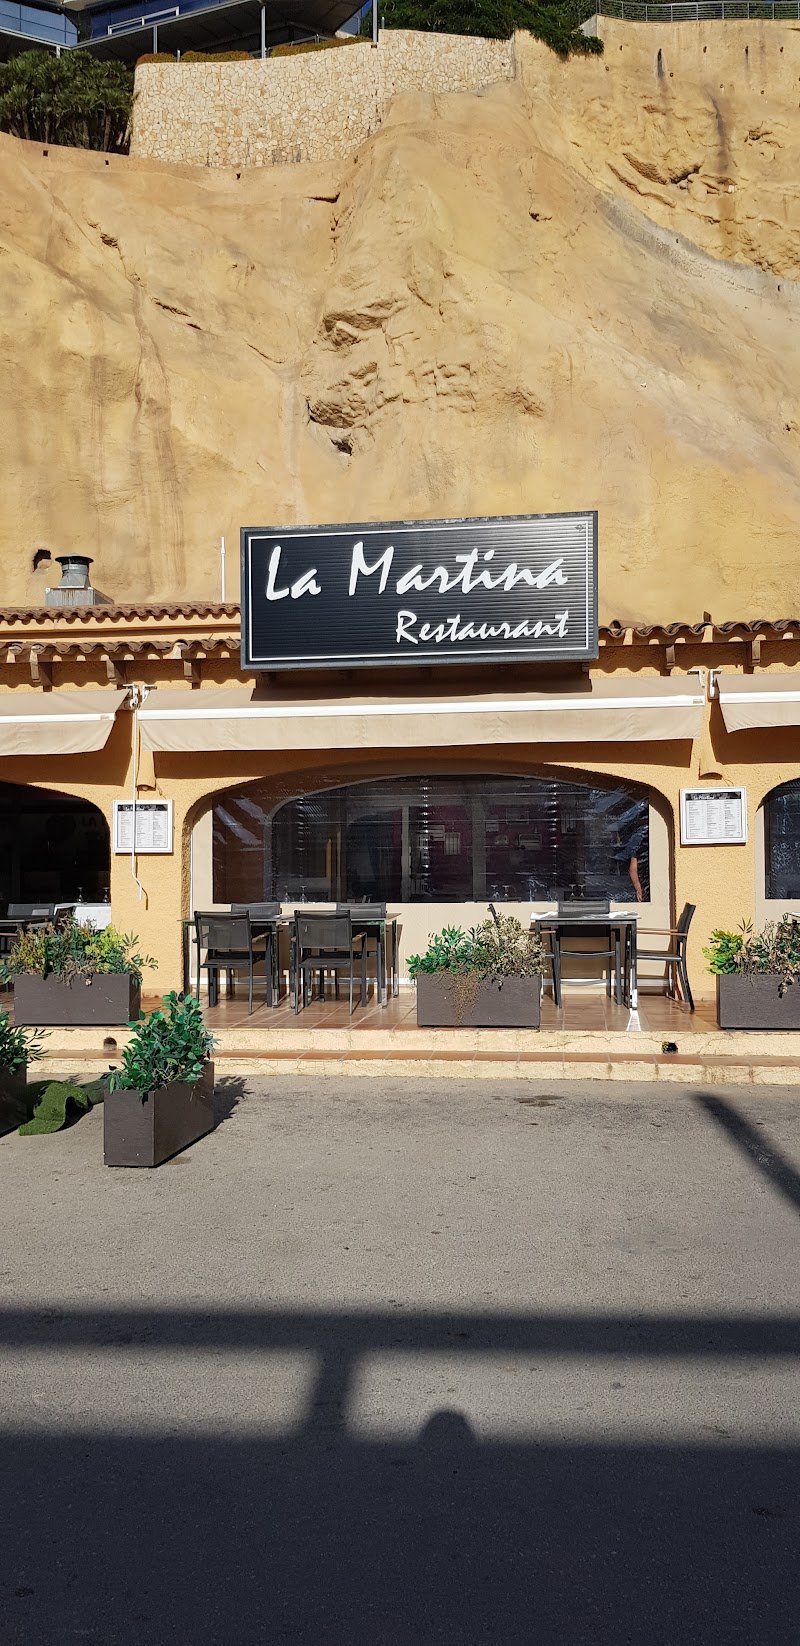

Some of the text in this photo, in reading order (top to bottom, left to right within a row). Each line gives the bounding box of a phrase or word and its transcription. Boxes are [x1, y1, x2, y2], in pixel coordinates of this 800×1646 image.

[265, 541, 568, 601] La Martina
[396, 610, 569, 645] Restaurant
